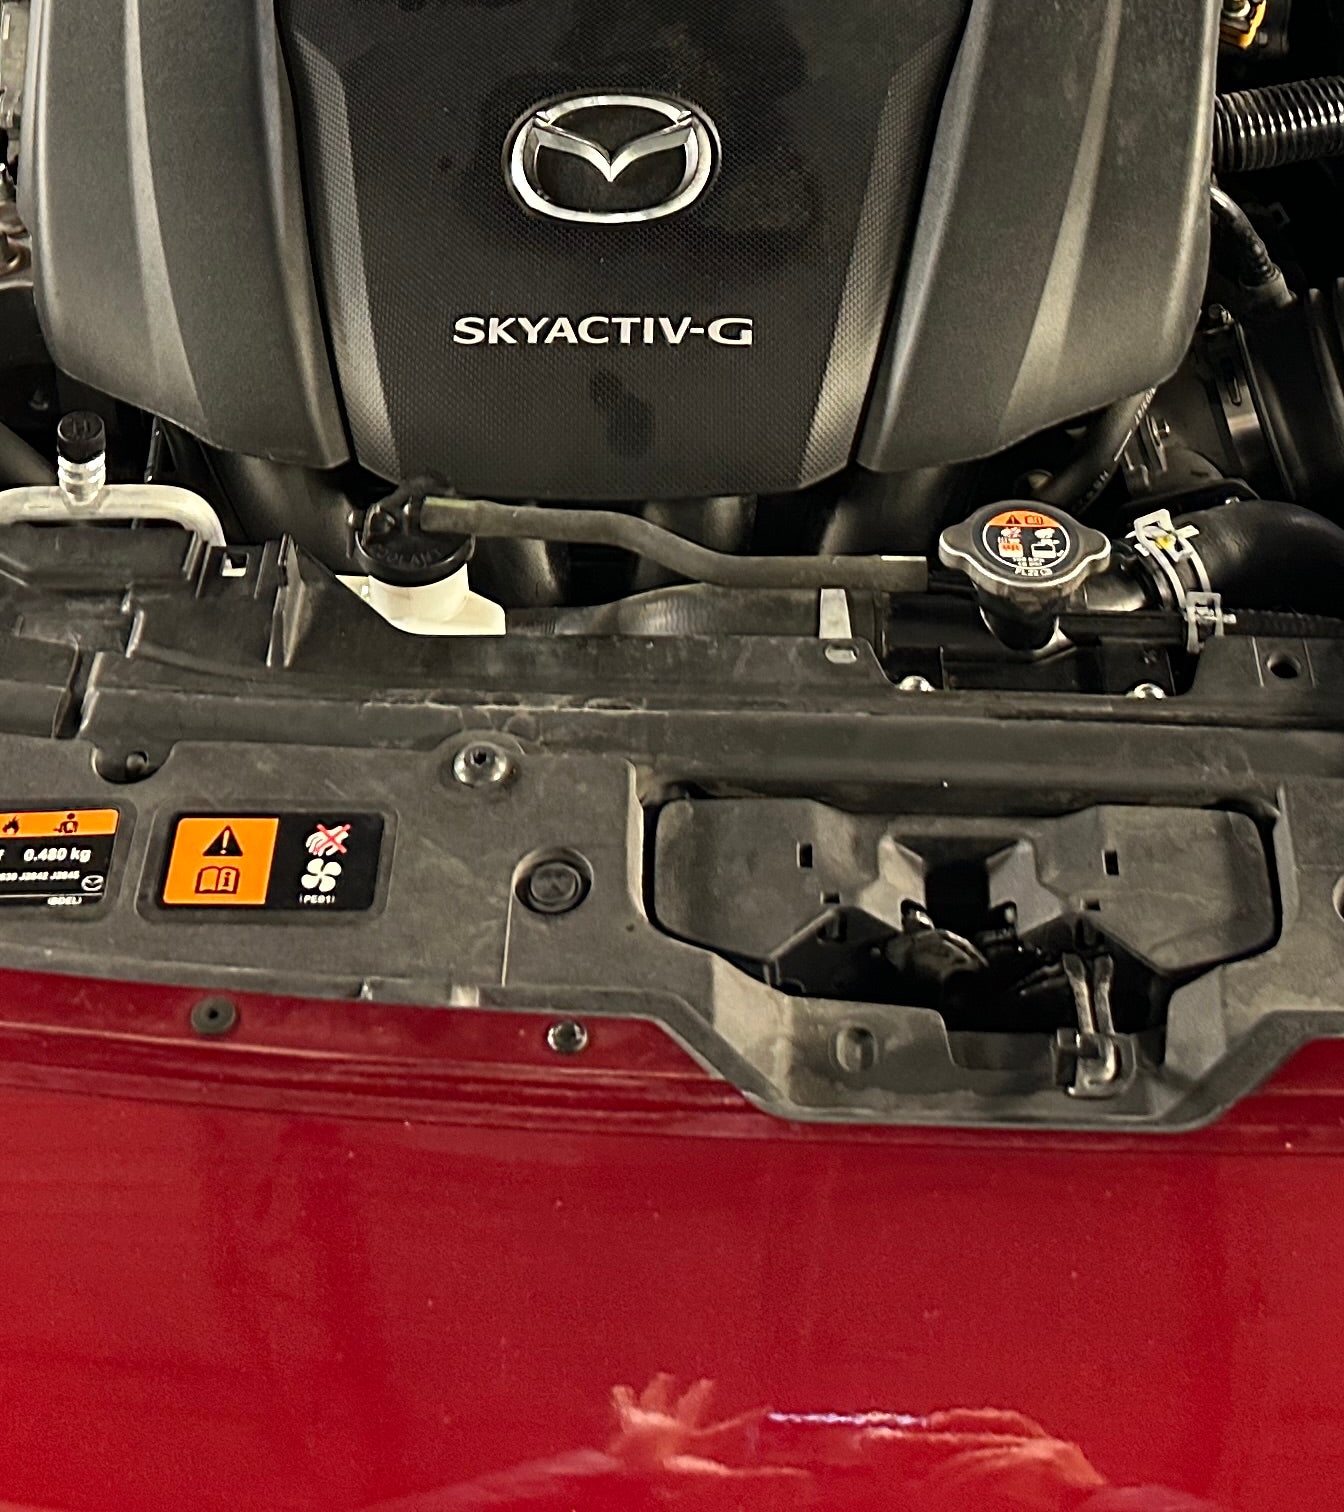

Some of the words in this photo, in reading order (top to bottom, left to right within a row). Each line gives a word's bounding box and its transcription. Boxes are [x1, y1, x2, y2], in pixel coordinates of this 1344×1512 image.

[453, 316, 753, 346] SKYACTIV-G
[23, 848, 68, 861] 0.480
[70, 847, 92, 863] kg
